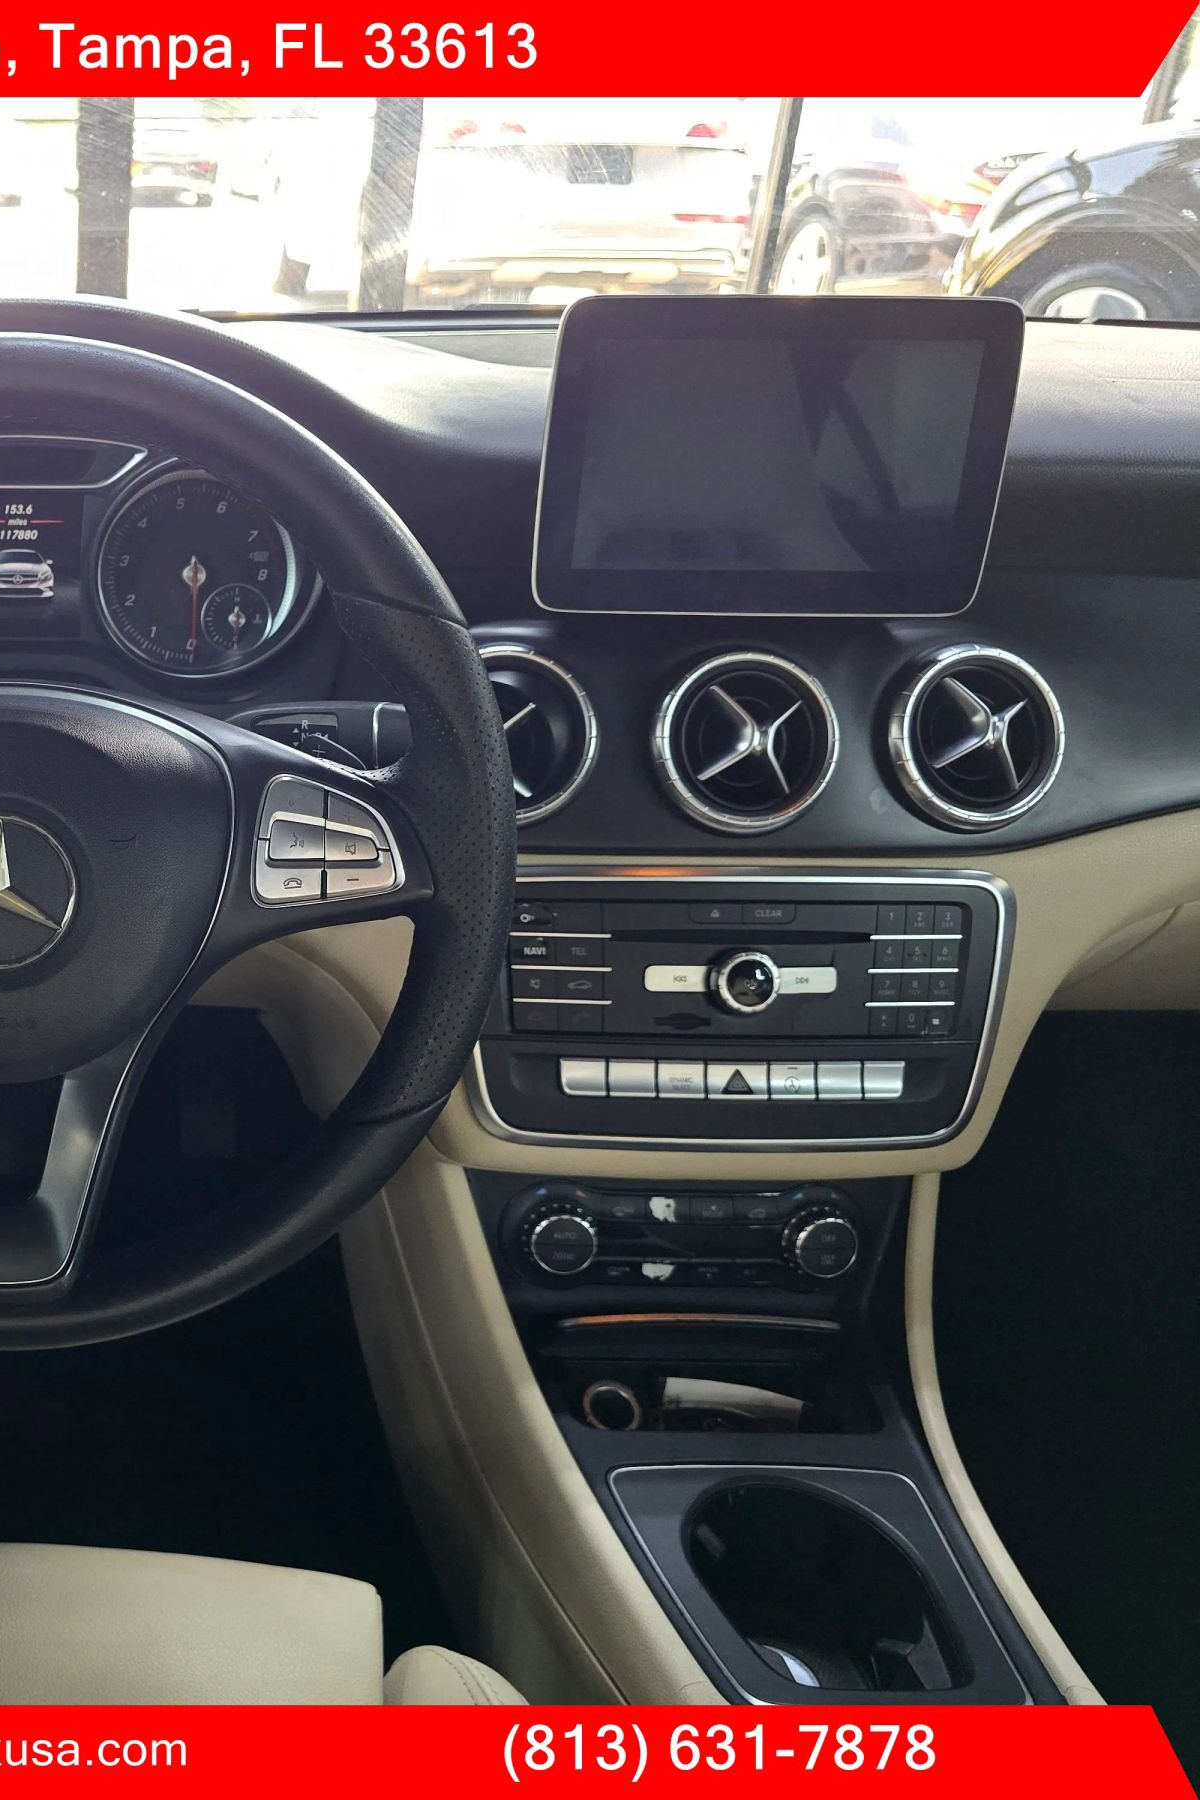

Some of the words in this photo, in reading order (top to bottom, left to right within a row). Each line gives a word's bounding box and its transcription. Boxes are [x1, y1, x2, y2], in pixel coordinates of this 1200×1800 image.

[4, 503, 33, 515] 153.6
[175, 498, 185, 510] 5
[216, 501, 227, 514] 6
[137, 517, 148, 529] 4
[0, 529, 39, 540] 117880
[247, 530, 259, 543] 7
[119, 555, 130, 567] 3
[257, 568, 269, 581] 8
[124, 594, 136, 606] 2
[149, 626, 158, 638] 1
[301, 720, 309, 730] R
[754, 908, 783, 918] CLEAR
[523, 946, 547, 956] NAVI
[570, 946, 588, 956] TEL
